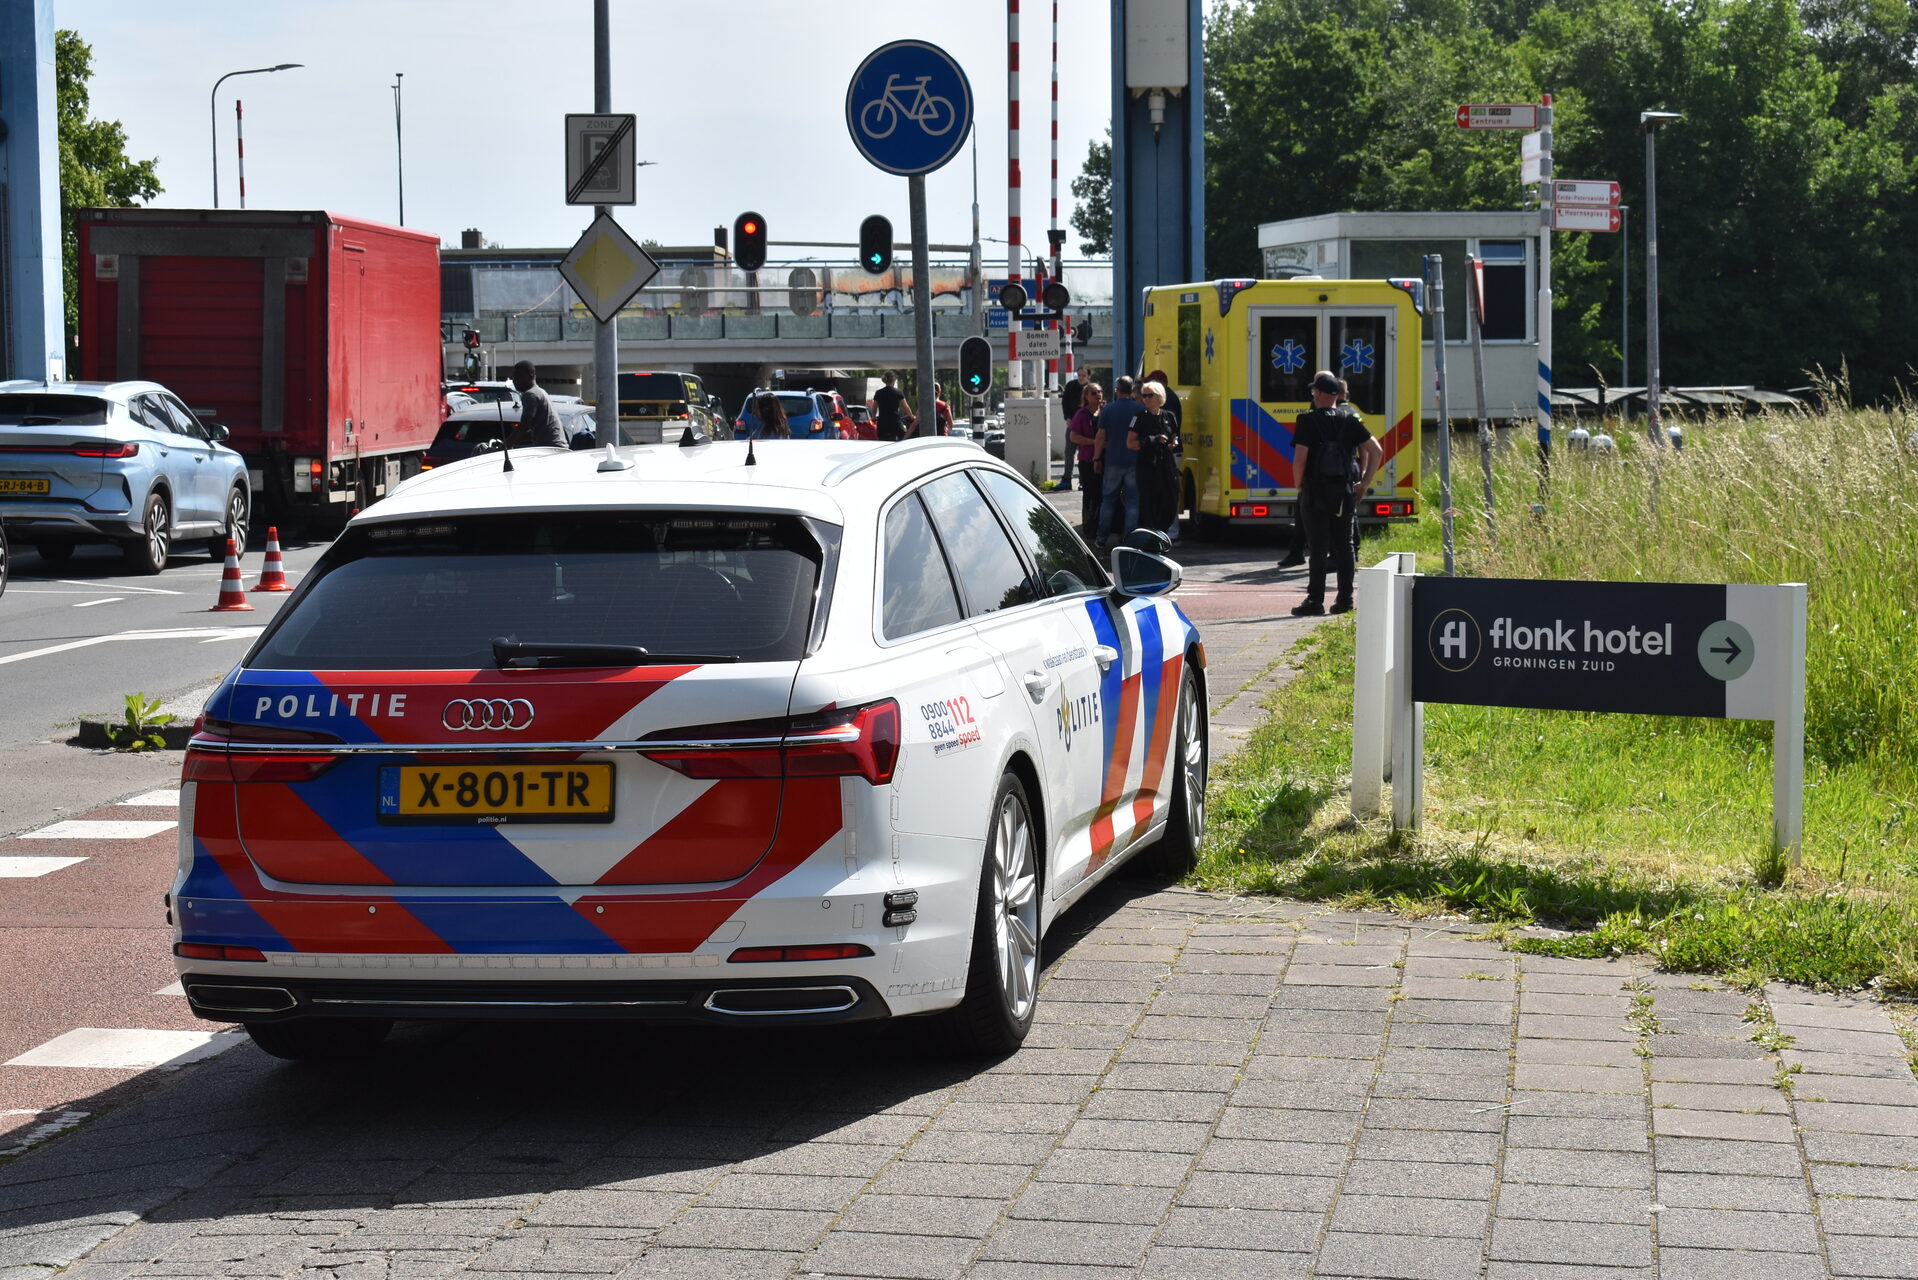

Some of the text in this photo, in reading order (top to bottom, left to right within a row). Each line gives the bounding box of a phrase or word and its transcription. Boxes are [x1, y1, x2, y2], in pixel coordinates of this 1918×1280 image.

[586, 120, 615, 129] ZONE
[1026, 332, 1049, 340] Bomen
[1017, 349, 1059, 357] automatisch
[1489, 617, 1673, 656] flonk hotel
[1493, 656, 1616, 672] GRONINGEN ZUID
[255, 693, 407, 720] POLITIE
[921, 696, 975, 726] 0900 112
[928, 719, 955, 740] 8844
[1056, 692, 1099, 752] POLITIE
[934, 725, 980, 754] geen spoed spoed
[417, 771, 590, 808] X-801-TR
[382, 795, 397, 807] NL
[477, 815, 507, 824] politie.nl
